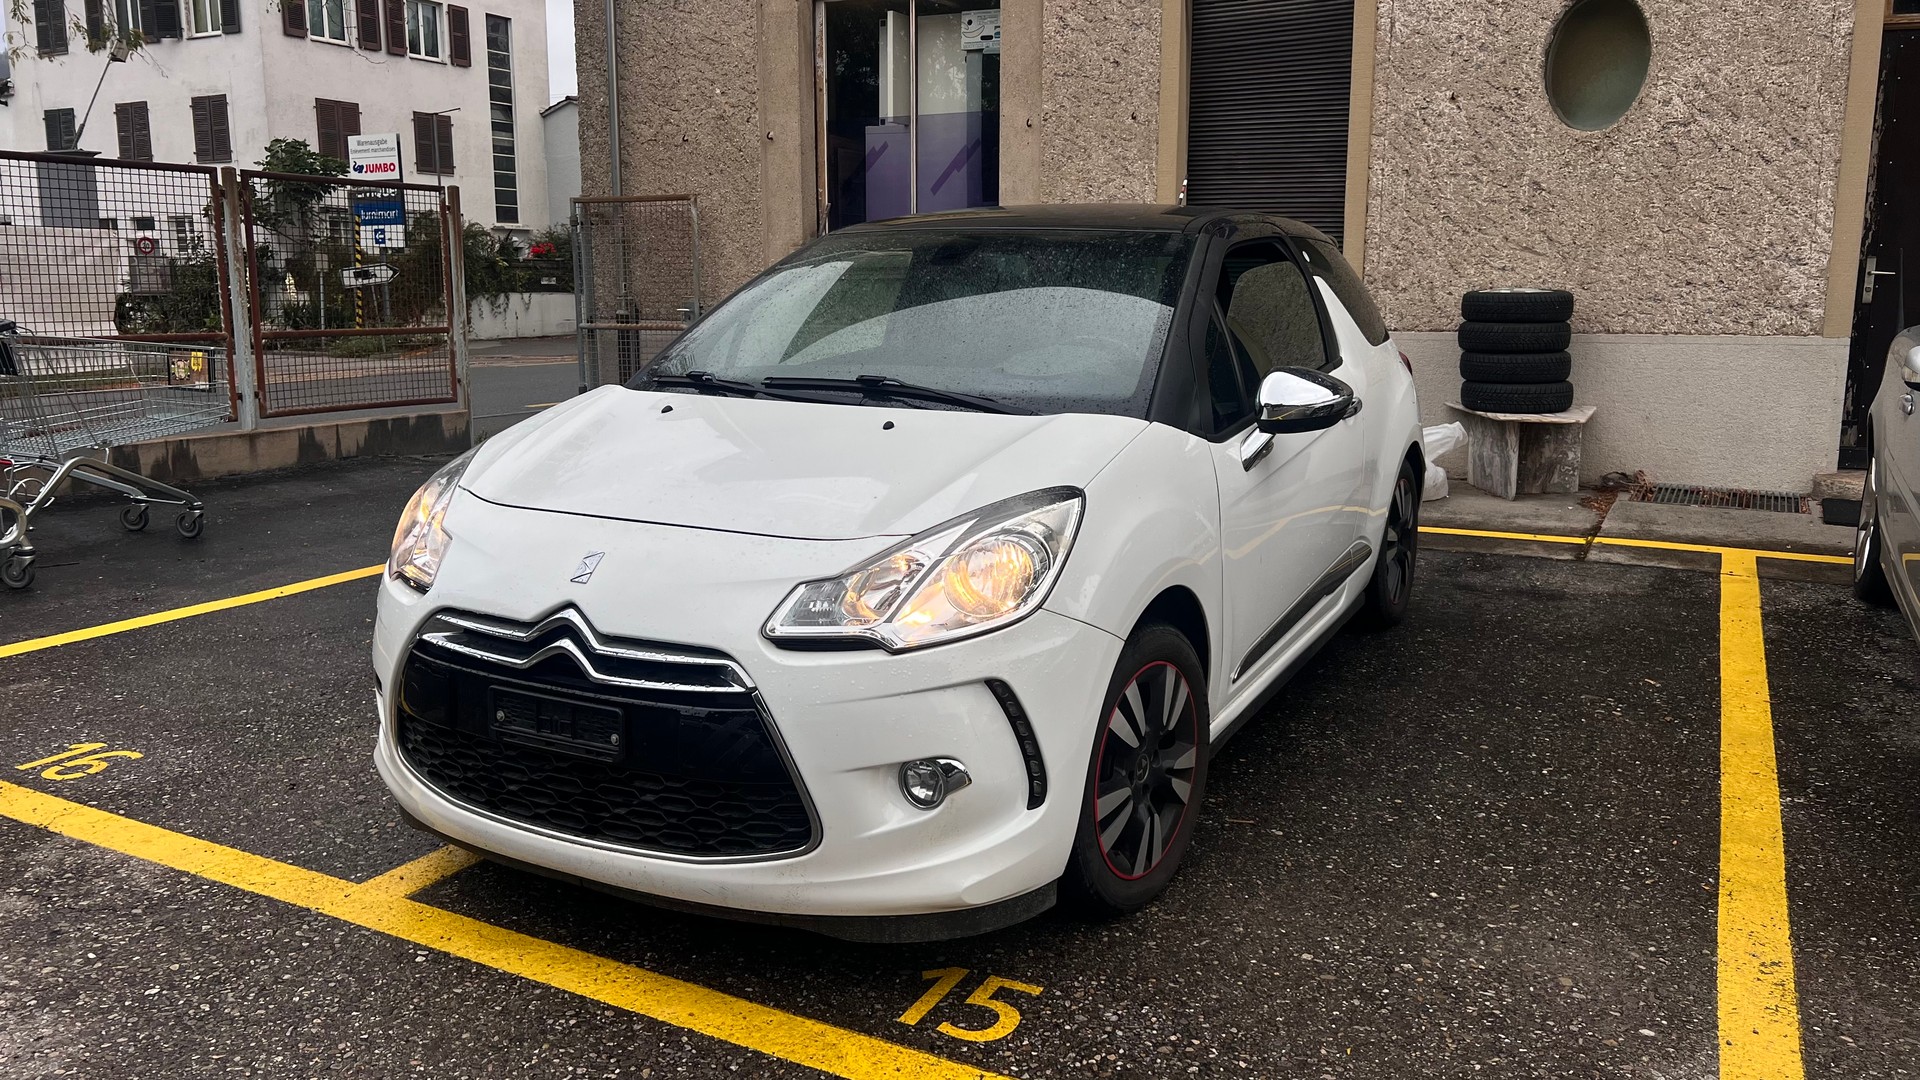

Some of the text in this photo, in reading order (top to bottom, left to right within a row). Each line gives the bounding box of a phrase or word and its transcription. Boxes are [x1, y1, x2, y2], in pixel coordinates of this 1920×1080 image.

[364, 162, 396, 173] JUMBO
[15, 742, 144, 780] 16
[897, 966, 1044, 1042] 15
